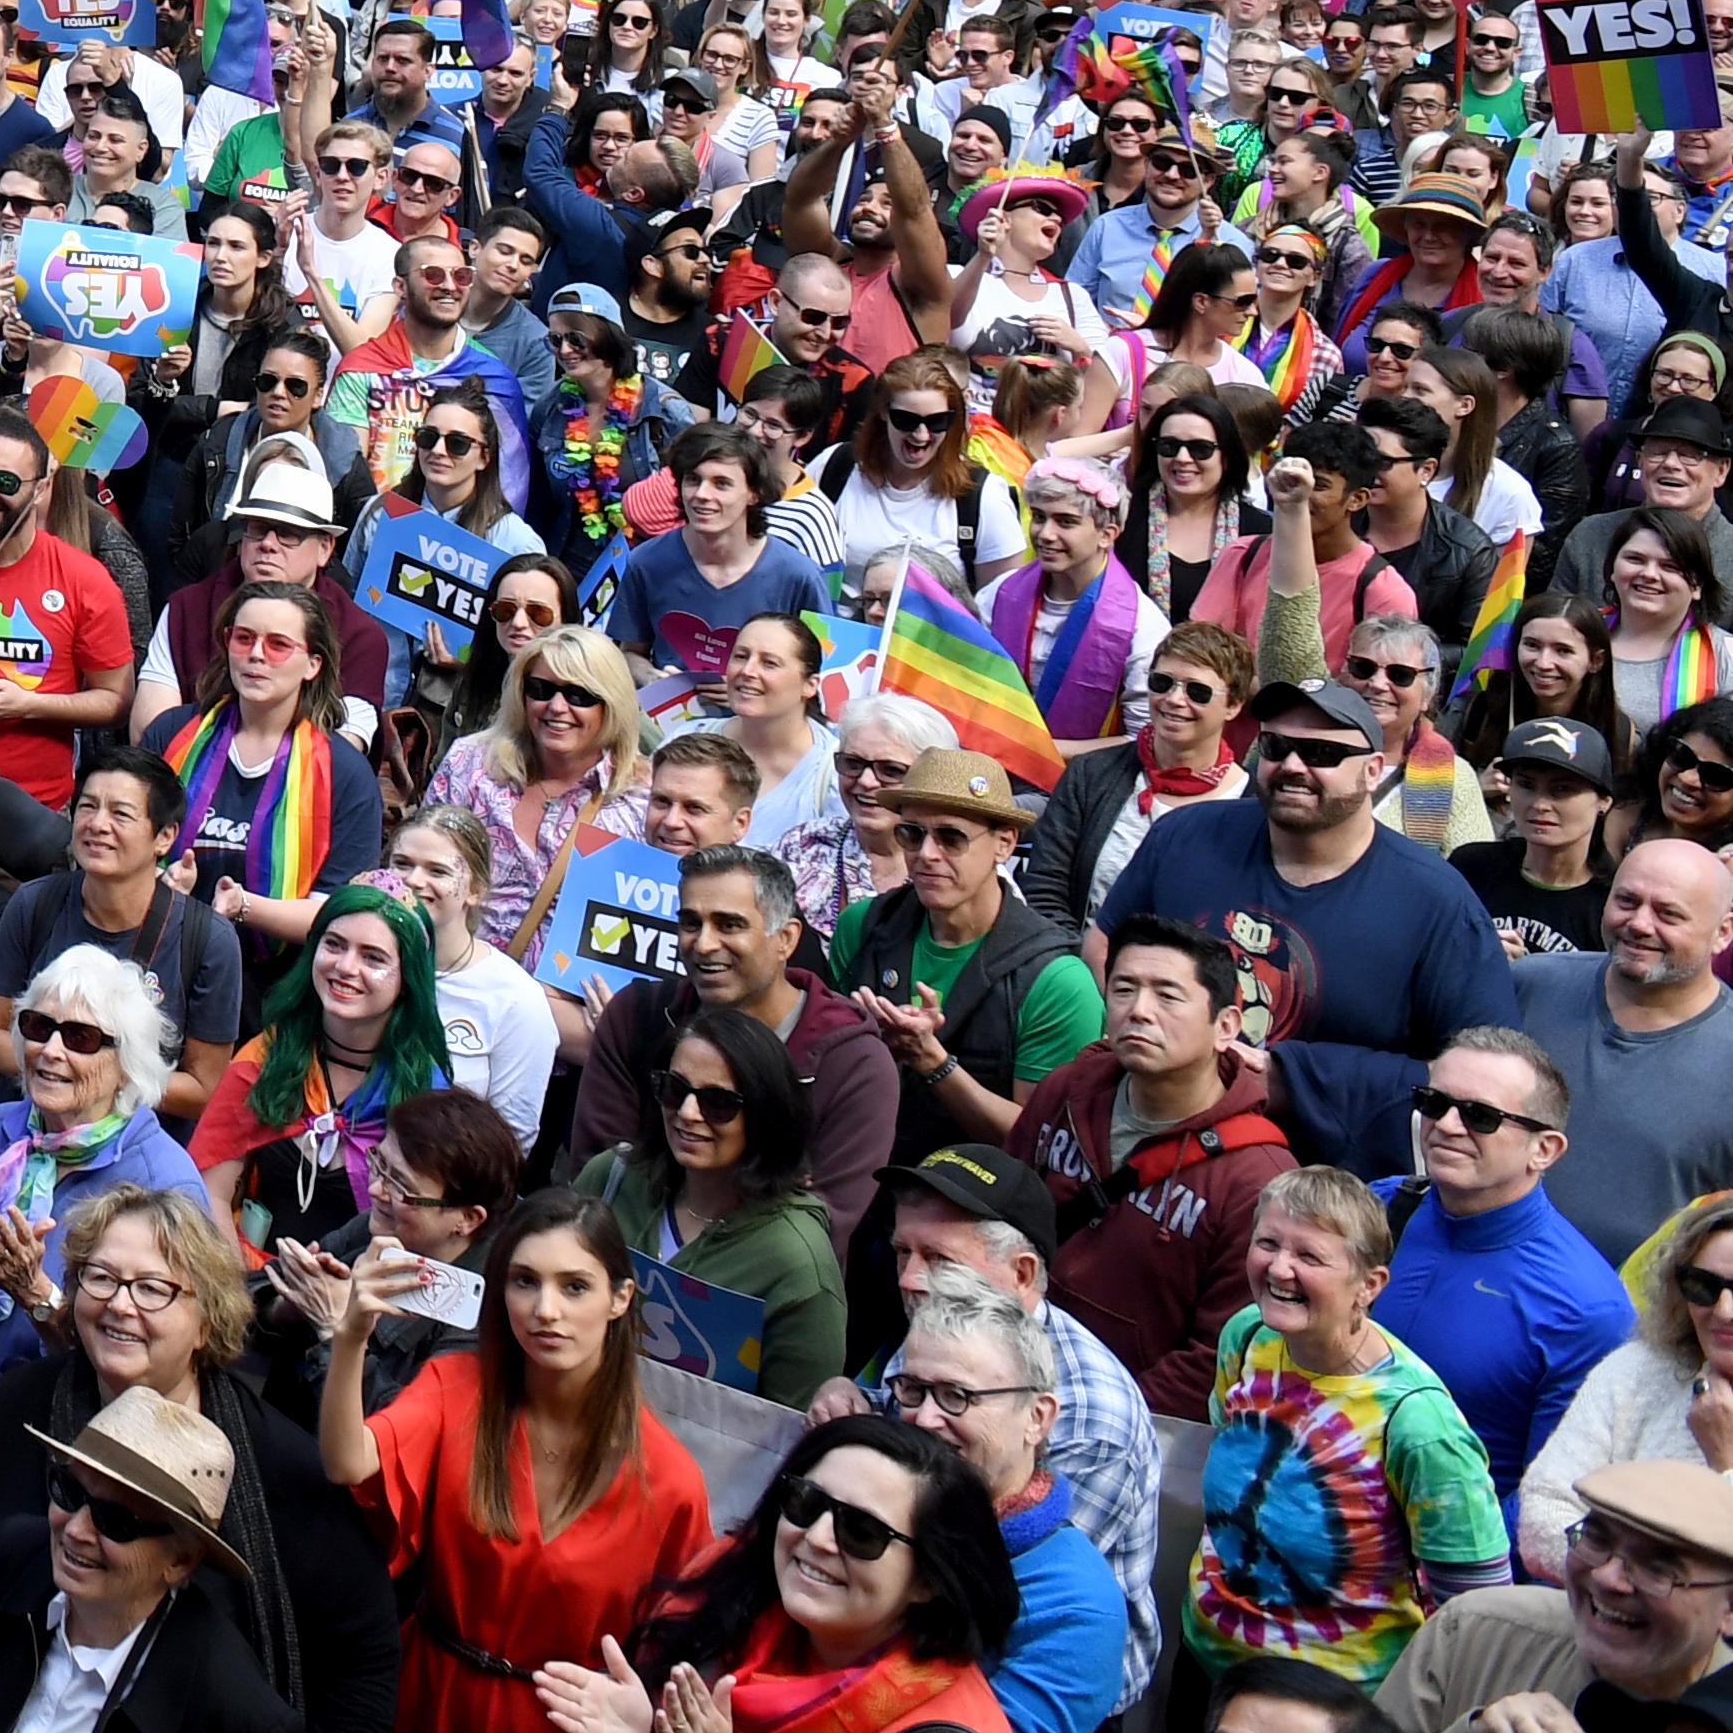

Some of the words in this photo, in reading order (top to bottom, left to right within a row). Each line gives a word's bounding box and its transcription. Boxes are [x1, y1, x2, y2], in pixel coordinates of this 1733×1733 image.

[63, 15, 117, 28] EQUALITY
[1120, 17, 1175, 39] VOT
[425, 71, 475, 89] VOT
[244, 183, 288, 202] EQUAL
[67, 250, 140, 269] EQUALITY
[61, 272, 144, 320] YES
[418, 533, 490, 585] VOTE
[614, 870, 681, 917] VOT
[632, 923, 688, 977] YE
[1491, 915, 1579, 954] PARTME
[1038, 1123, 1208, 1239] BROLYN
